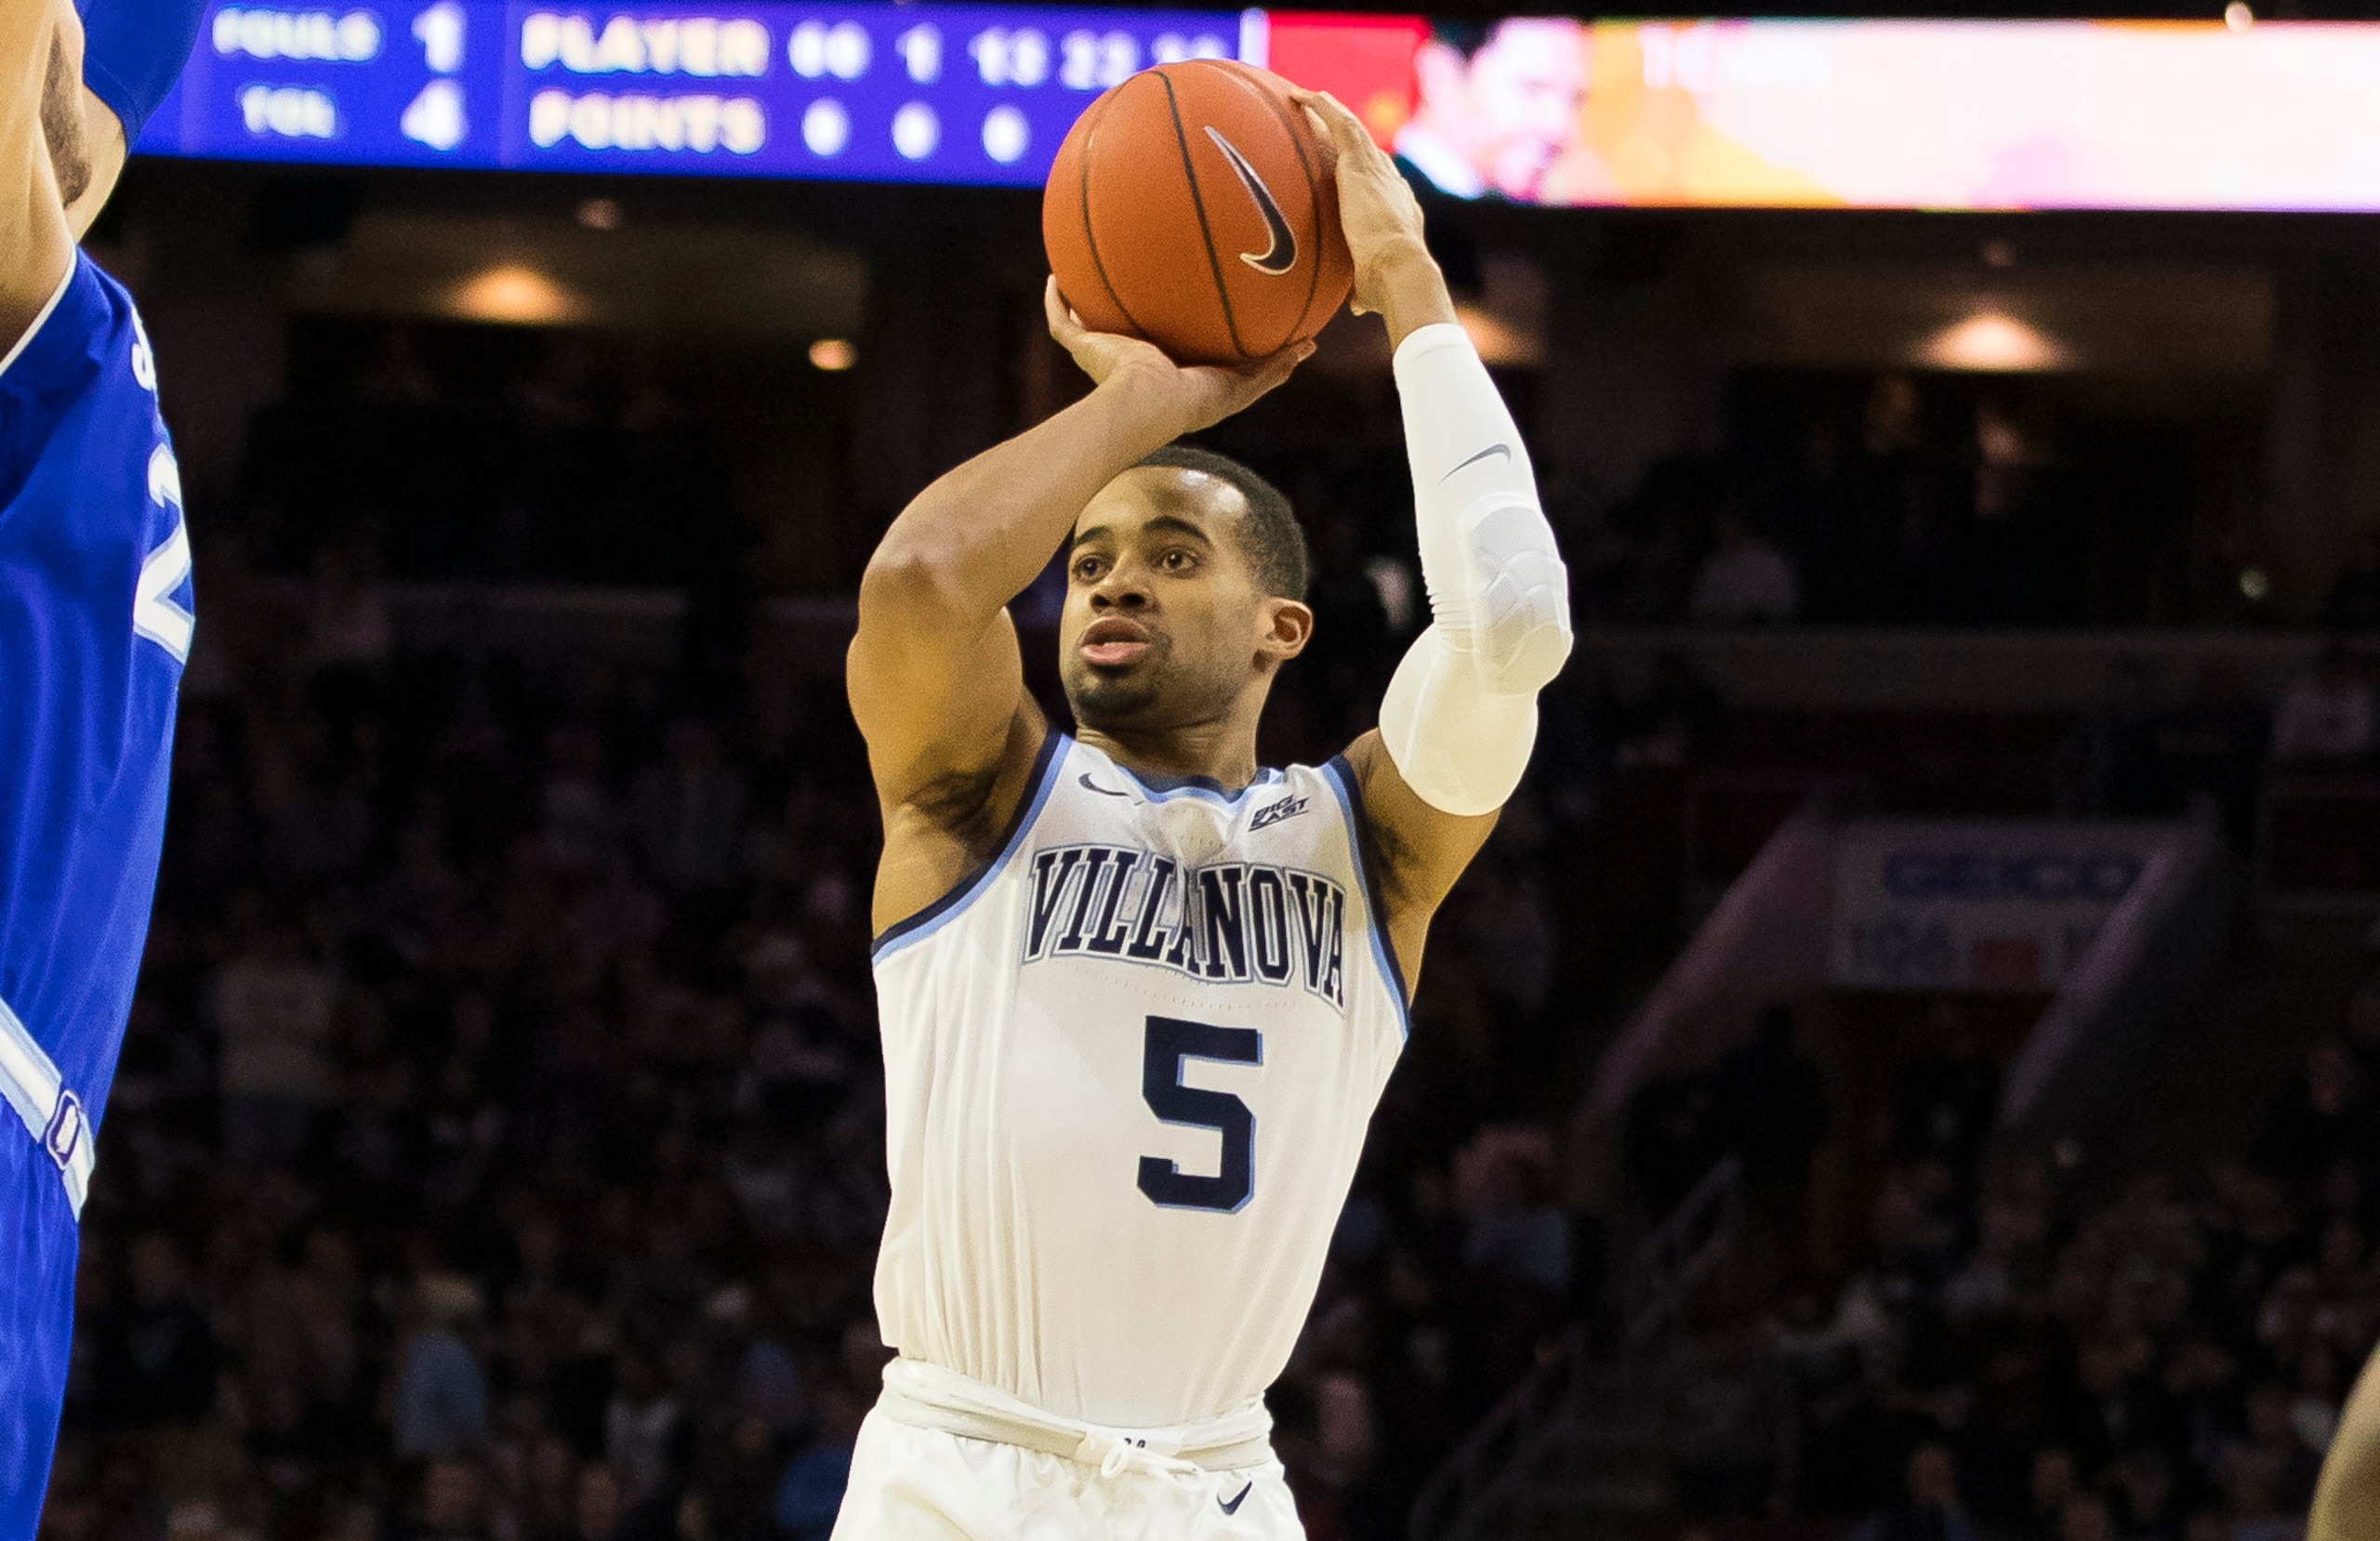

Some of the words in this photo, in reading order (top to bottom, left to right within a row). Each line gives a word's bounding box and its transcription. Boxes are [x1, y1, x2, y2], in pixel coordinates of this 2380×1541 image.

[411, 2, 465, 74] 1
[520, 12, 772, 78] PLAYER
[896, 24, 942, 84] 1
[400, 79, 466, 152] 4
[527, 89, 767, 155] POINTS
[801, 98, 850, 158] 0
[892, 100, 940, 161] 0
[982, 104, 1030, 165] 0
[1250, 797, 1310, 830] EAST
[1252, 793, 1294, 821] BIG
[1023, 842, 1346, 1017] VILLANOVA
[1137, 1015, 1263, 1215] 5
